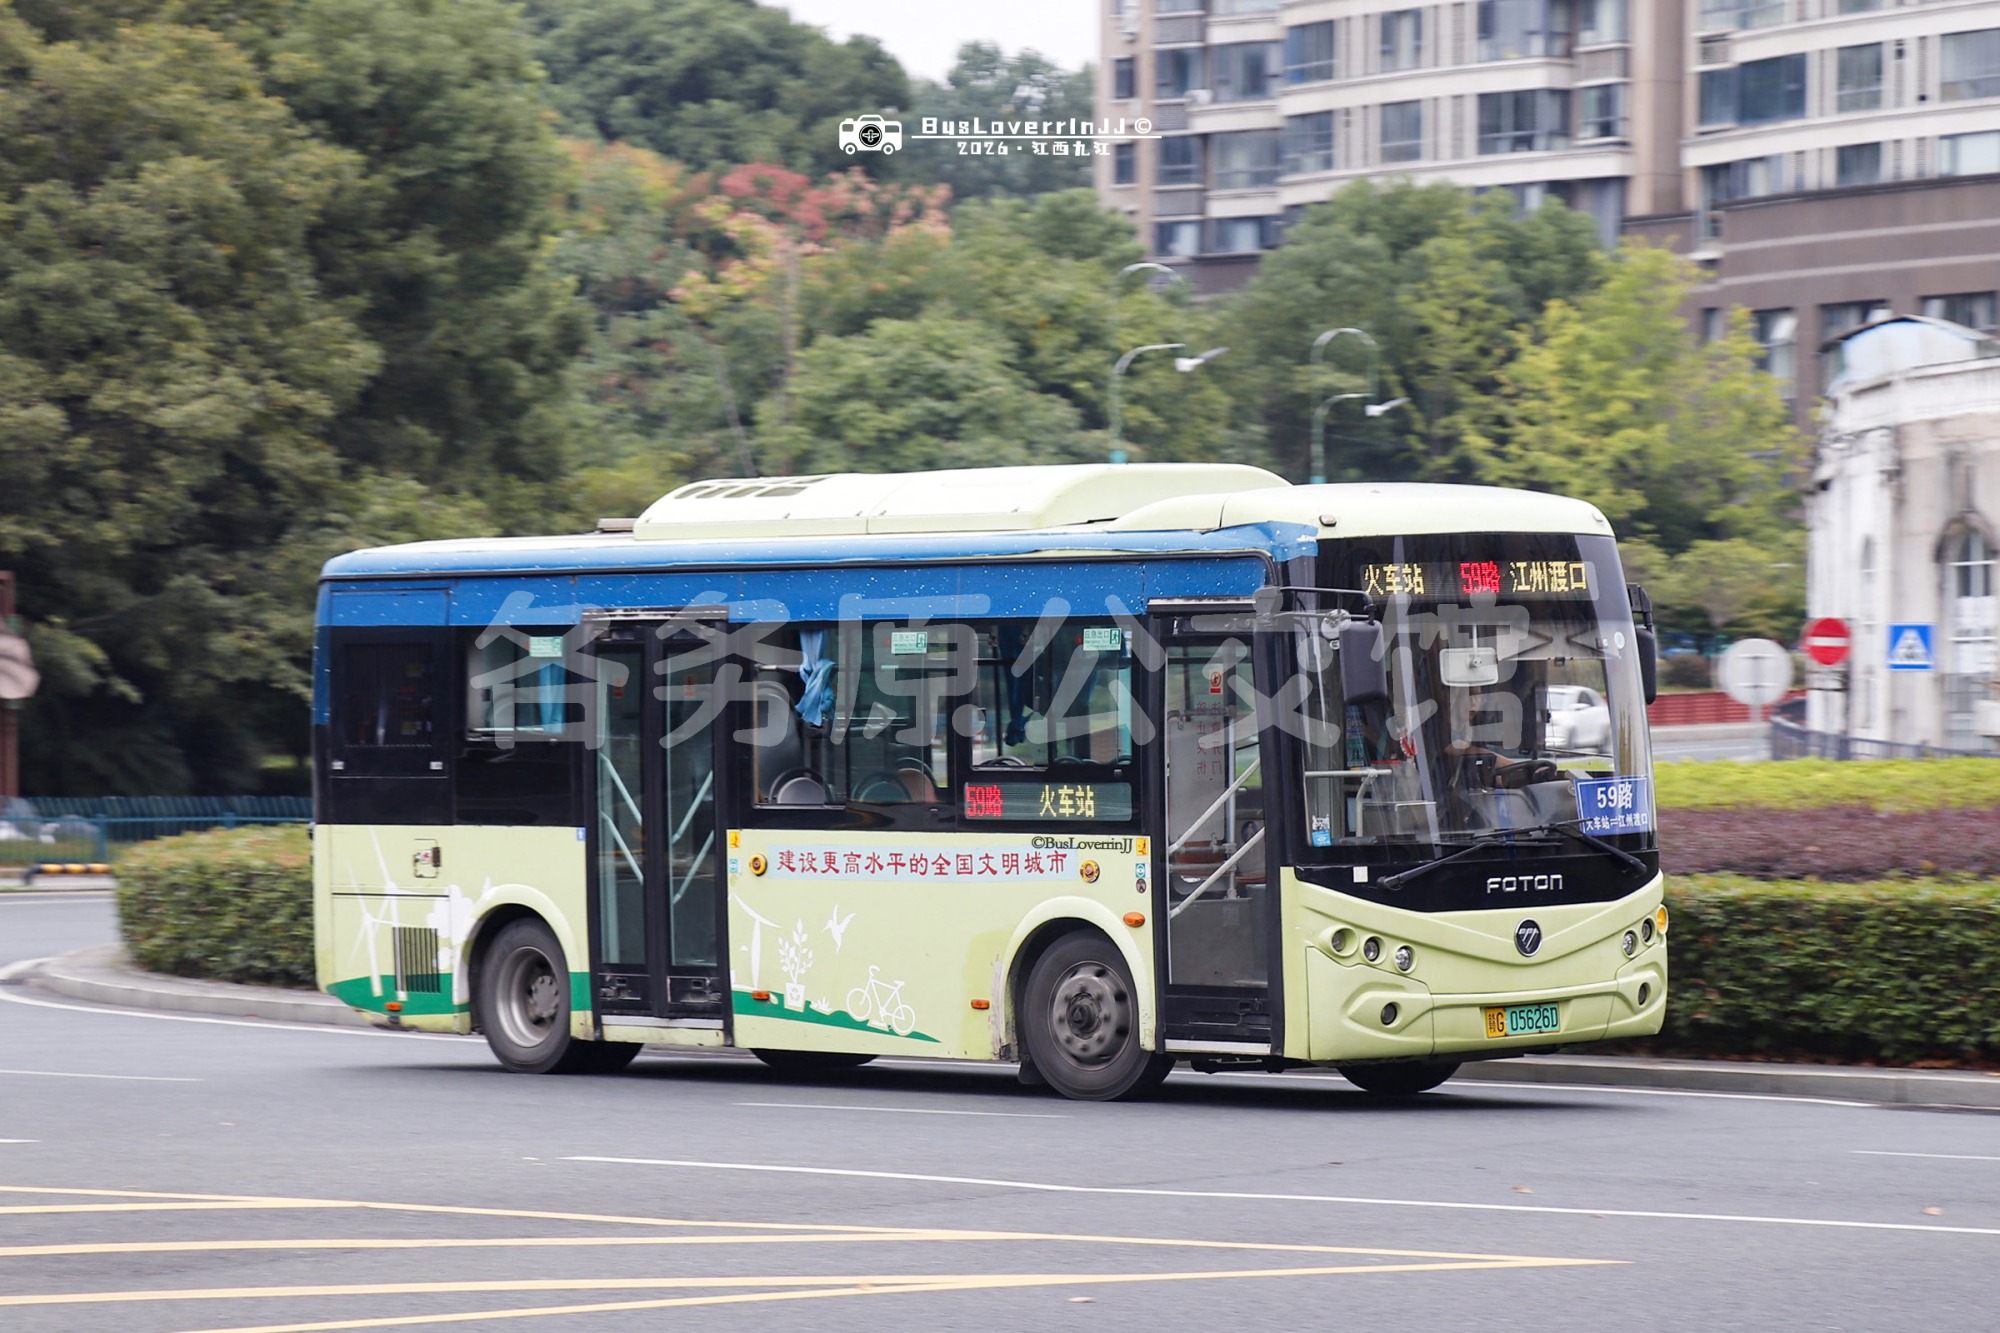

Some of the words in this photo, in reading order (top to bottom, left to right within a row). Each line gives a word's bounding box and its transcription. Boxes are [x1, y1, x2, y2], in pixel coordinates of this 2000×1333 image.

[1364, 562, 1425, 595] 火车站
[1459, 560, 1501, 594] 59路
[1509, 561, 1588, 592] 江州渡口
[965, 784, 1003, 817] 59路
[1039, 784, 1095, 818] 火车站
[1596, 781, 1633, 809] 59路
[777, 849, 1068, 876] 建设更高水平的全国文明城市
[1486, 874, 1563, 894] FOTON
